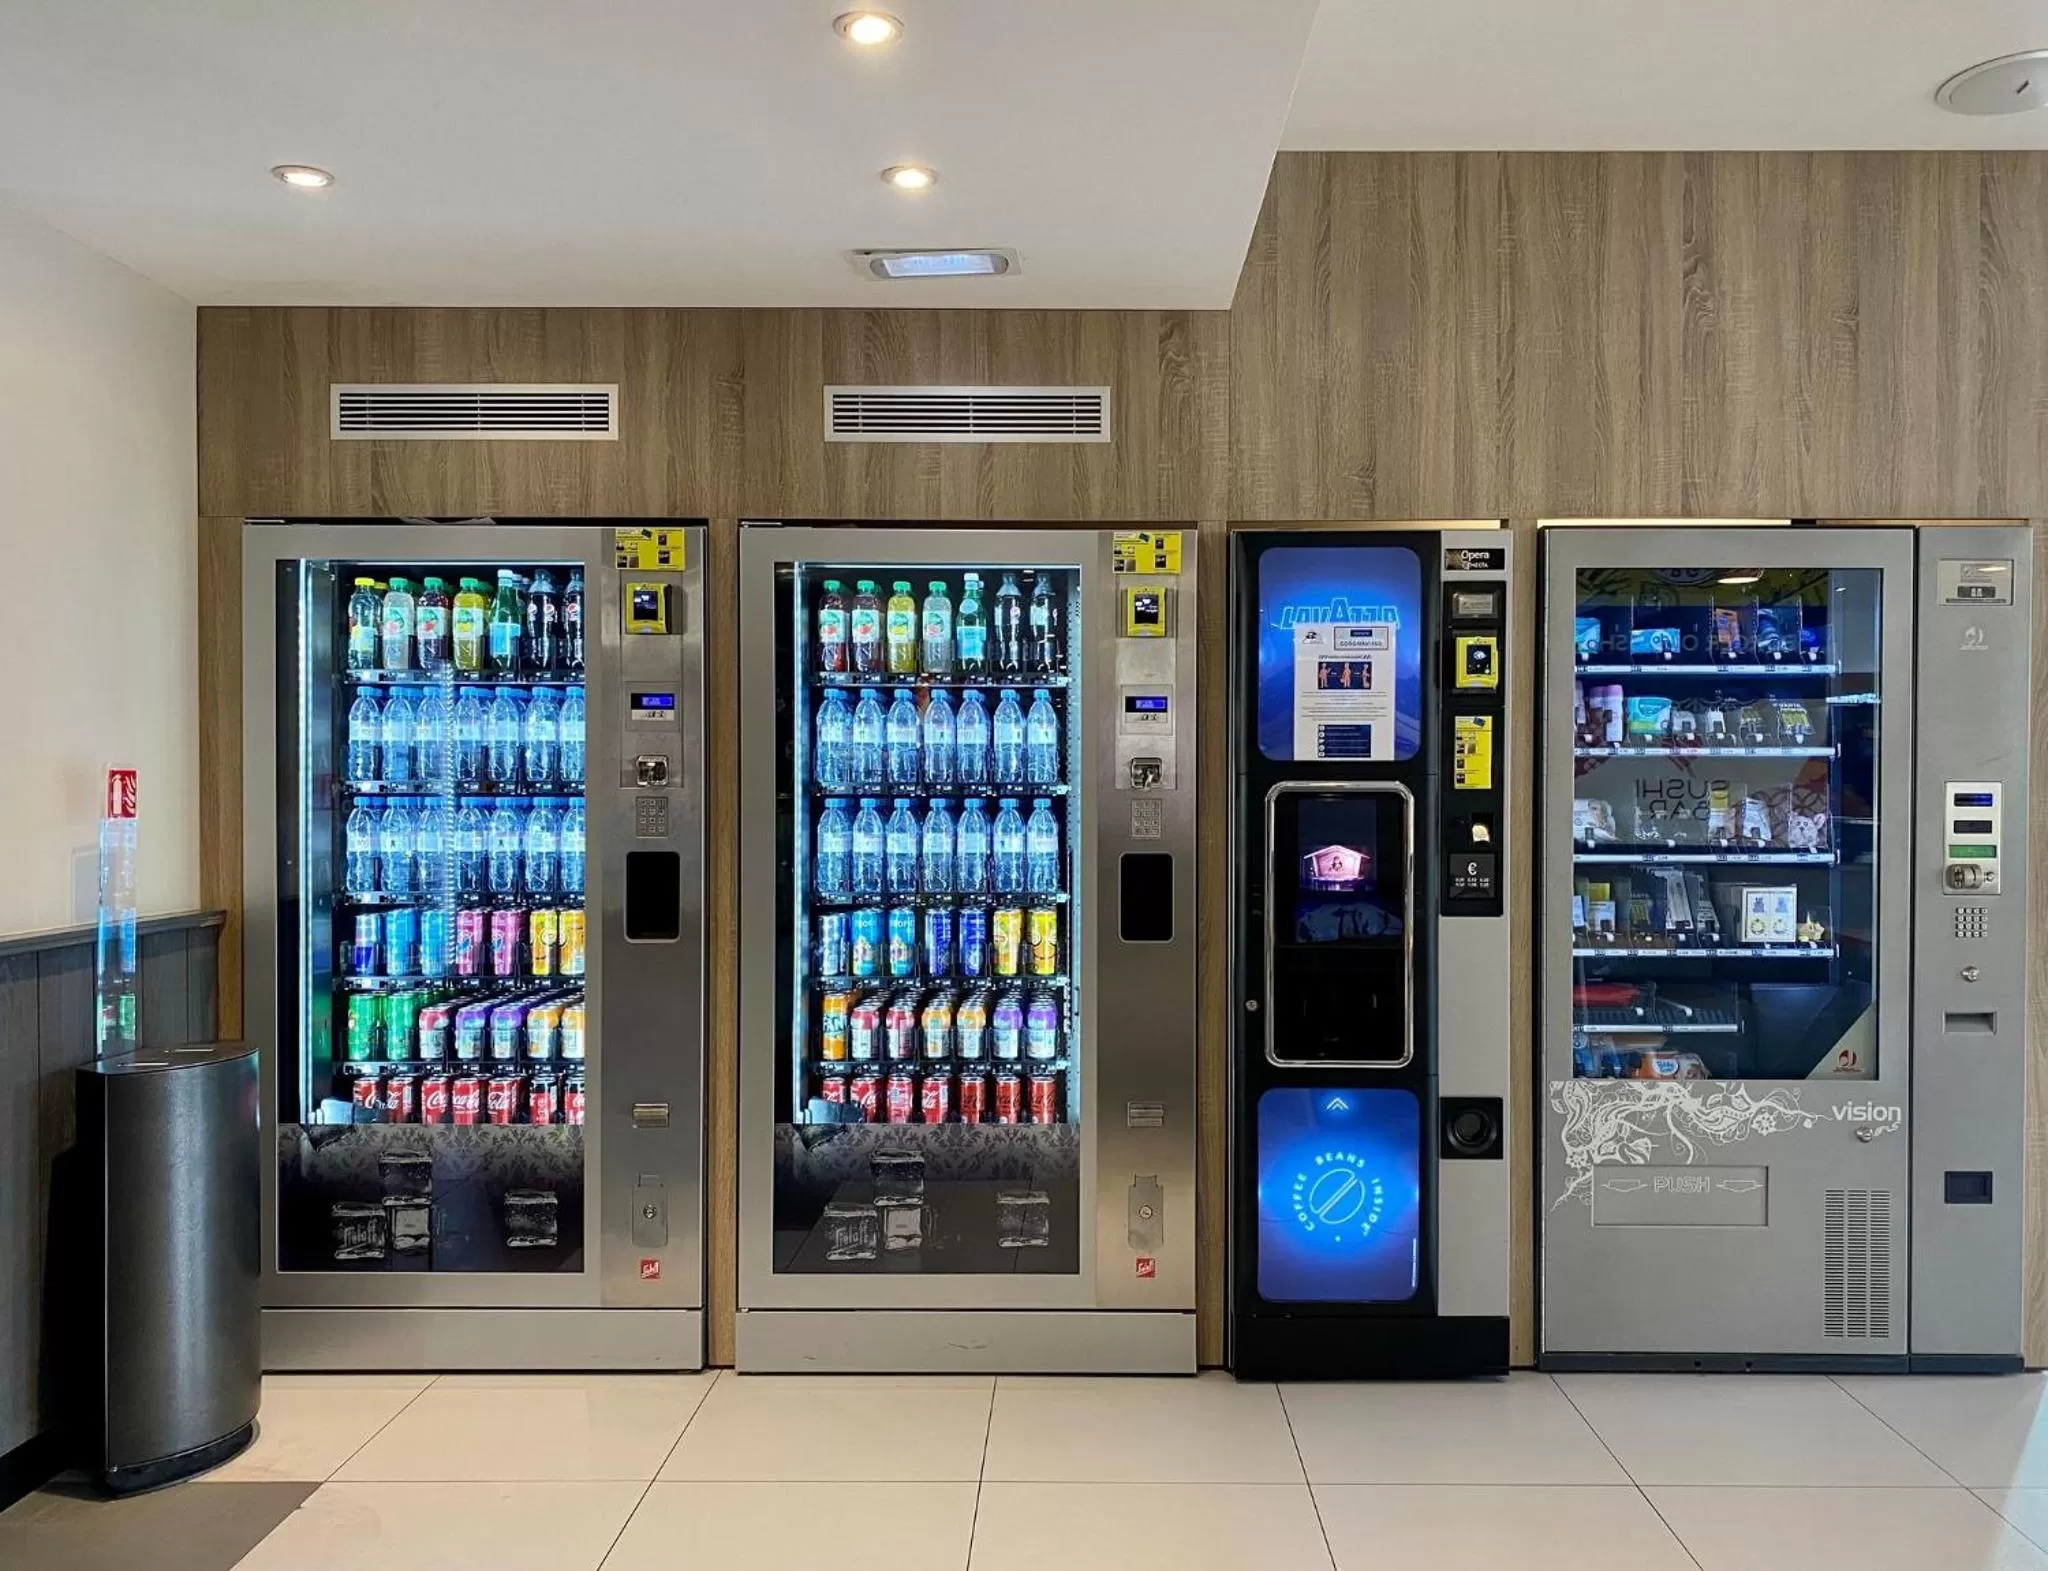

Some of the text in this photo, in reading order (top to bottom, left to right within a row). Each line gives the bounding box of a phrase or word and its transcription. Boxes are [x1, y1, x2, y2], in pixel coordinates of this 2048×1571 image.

[1461, 550, 1490, 561] Opera
[1831, 1101, 1902, 1121] vision
[1653, 1175, 1711, 1193] PUSH
[1292, 1151, 1384, 1237] COFFEE BEANS INSIDE
